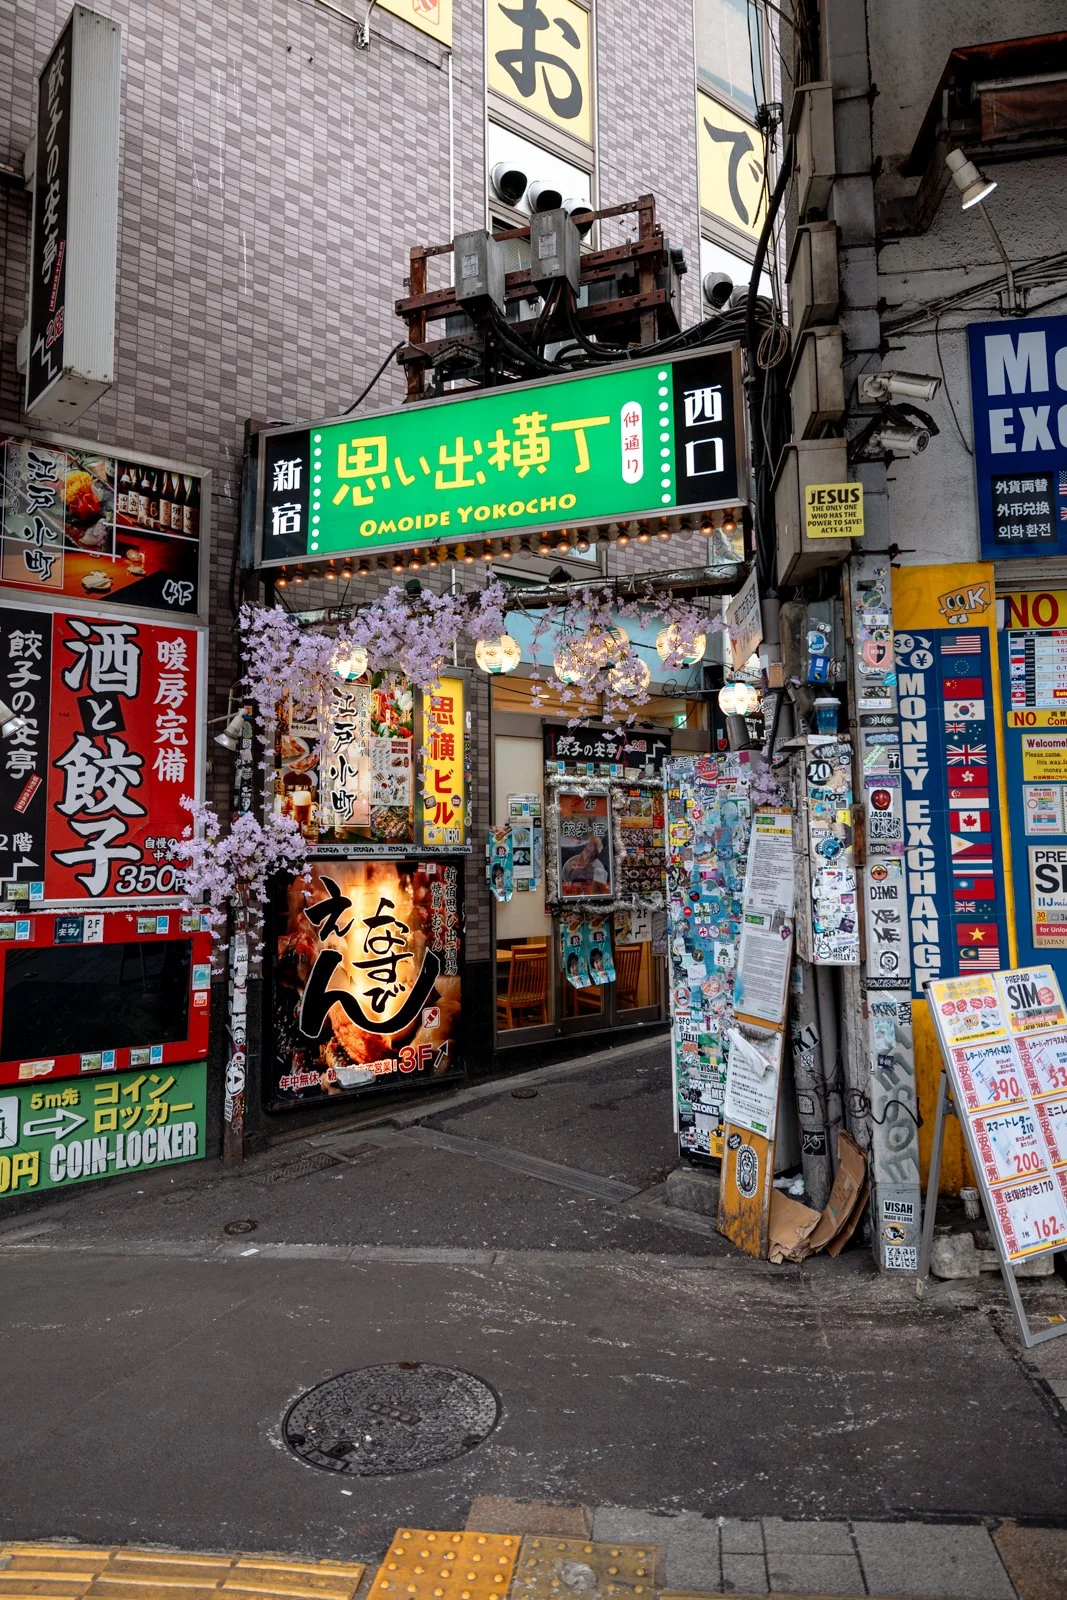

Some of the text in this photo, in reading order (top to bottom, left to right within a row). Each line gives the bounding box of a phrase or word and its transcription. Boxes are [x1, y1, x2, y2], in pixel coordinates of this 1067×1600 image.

[495, 0, 583, 119] お
[42, 47, 65, 284] 餃子の安亭
[704, 117, 763, 225] で
[624, 411, 640, 474] 仲通り
[684, 385, 724, 477] 西口
[989, 404, 1067, 454] EX
[332, 411, 610, 507] 思い出横丁
[271, 457, 303, 536] 新宿
[808, 488, 860, 505] JESUS
[995, 478, 1048, 495] 外貨両替
[24, 451, 58, 582] 江戸小町
[359, 493, 577, 537] OMOIDE YOKOCHO
[996, 501, 1050, 517] 外币兑换
[998, 523, 1051, 539] 외화 환전
[162, 579, 194, 605] 4F
[1009, 594, 1059, 628] NO
[5, 629, 43, 780] 餃子の安亭
[152, 636, 190, 784] 暖房完備
[1014, 712, 1037, 727] NO
[53, 618, 148, 897] 酒と餃子
[330, 686, 358, 820] 江戸小町
[430, 695, 455, 826] 思横ビル
[557, 739, 617, 758] 餃子の安亭
[584, 798, 597, 811] 2F
[444, 828, 461, 843] NERO
[898, 673, 942, 993] MONEY EXCHANGE
[87, 919, 100, 929] 2F
[431, 881, 442, 952] 焼鳥・おでん
[444, 866, 458, 976] 新宿思ひ出酒場
[637, 908, 648, 919] 2F
[300, 876, 440, 1039] えん
[352, 897, 414, 1014] なすび
[1005, 973, 1030, 984] PREPAID
[1007, 982, 1042, 1010] SIM
[399, 1044, 432, 1073] 3F
[30, 1088, 80, 1110] 5m先
[94, 1074, 176, 1105] コイン
[94, 1099, 193, 1133] ロッカー
[986, 1116, 1032, 1133] スマートレター
[1021, 1124, 1034, 1135] 210
[50, 1121, 198, 1182] COIN-LOCKER
[1013, 1151, 1045, 1174] 200円
[885, 1202, 913, 1214] VISAH
[1004, 1181, 1054, 1203] 往復はがき170
[1034, 1216, 1065, 1239] 162円
